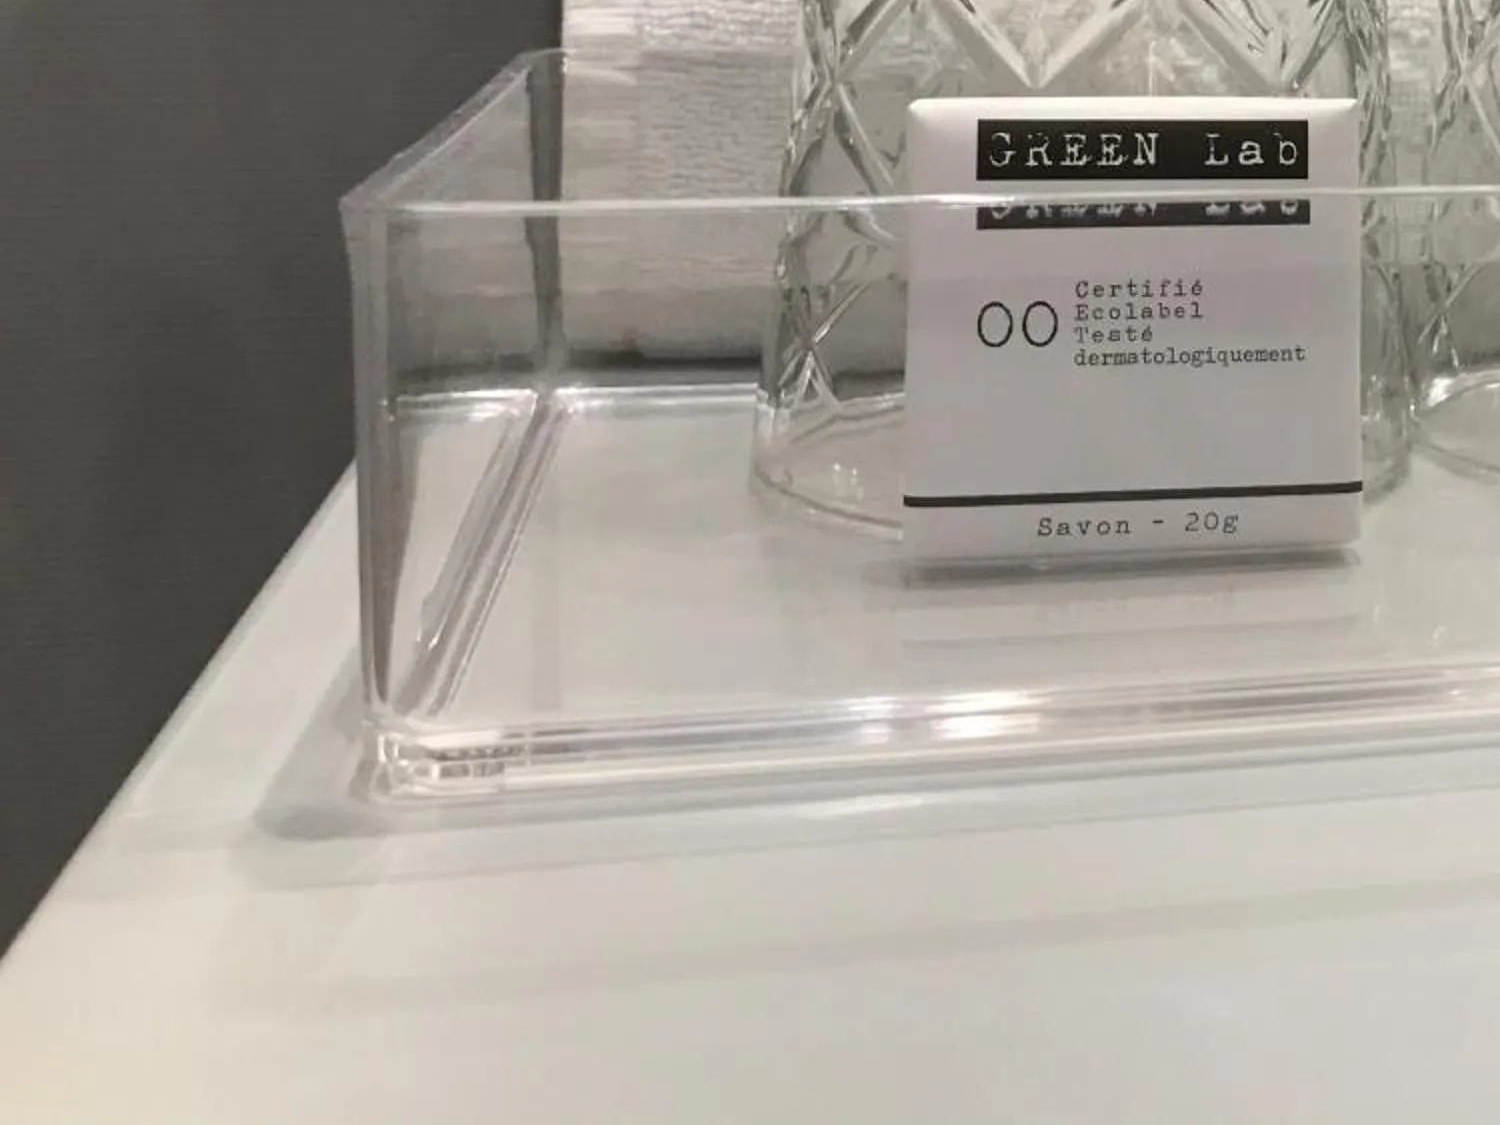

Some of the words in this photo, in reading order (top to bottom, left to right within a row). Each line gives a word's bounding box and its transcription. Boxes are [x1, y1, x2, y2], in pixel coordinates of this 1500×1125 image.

[989, 131, 1160, 167] GREEN
[1203, 131, 1299, 167] Lab
[1075, 279, 1204, 299] Certifié
[1075, 301, 1204, 323] Ecolabel
[1074, 324, 1153, 344] Testé
[1073, 345, 1306, 368] dermatologiquement
[1037, 517, 1132, 538] Savon
[1184, 511, 1240, 535] 20g
